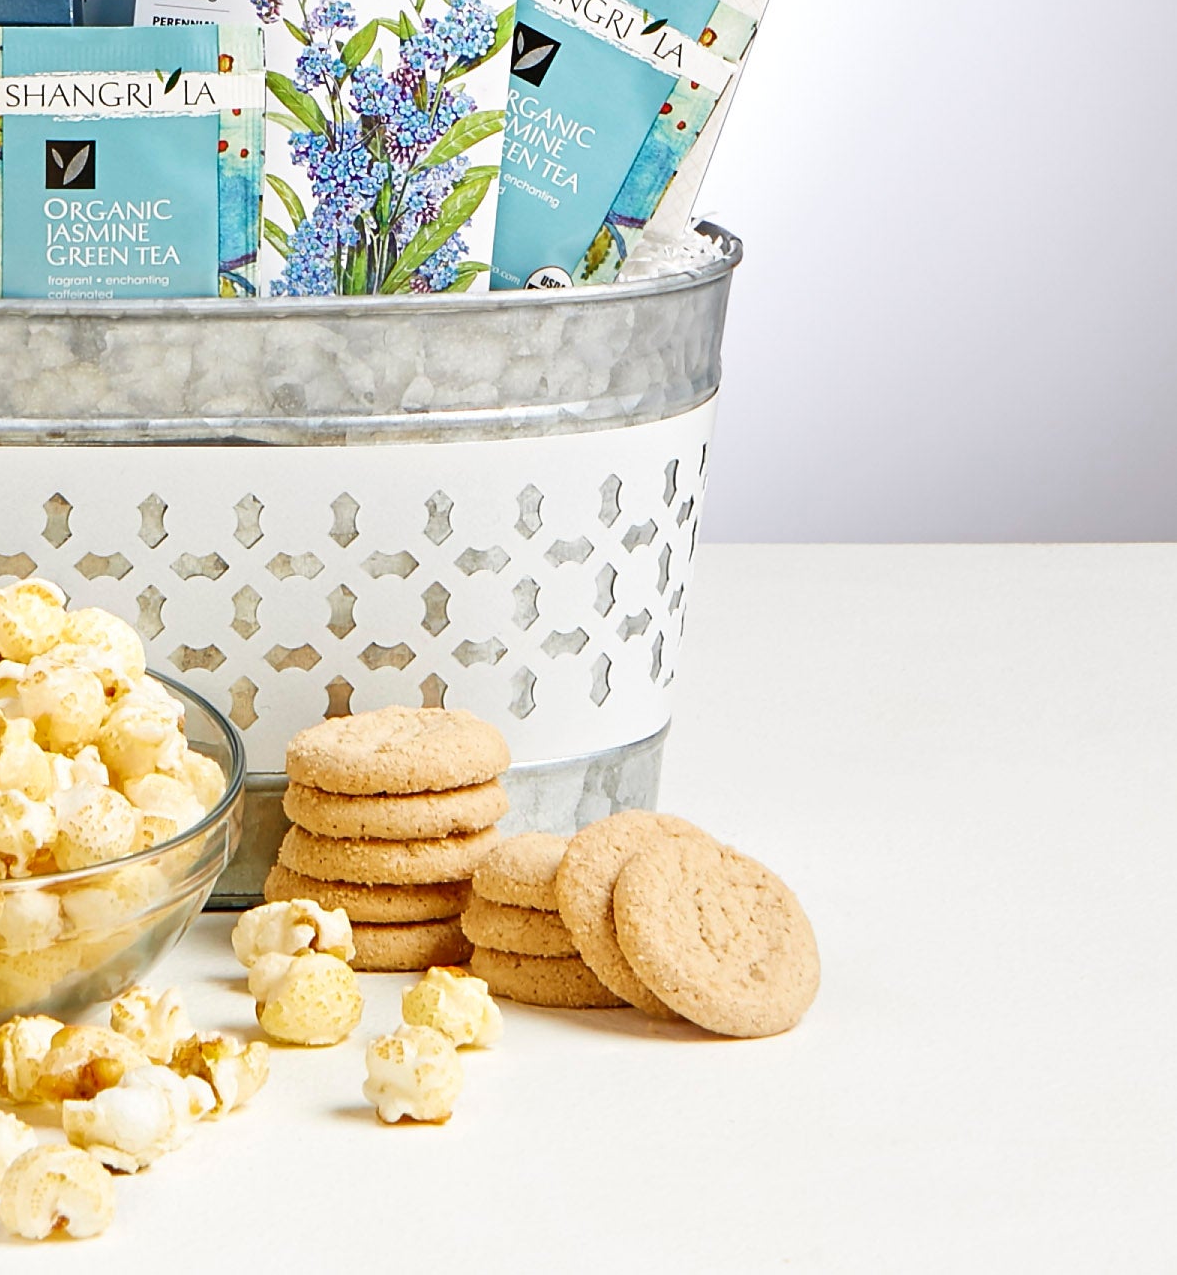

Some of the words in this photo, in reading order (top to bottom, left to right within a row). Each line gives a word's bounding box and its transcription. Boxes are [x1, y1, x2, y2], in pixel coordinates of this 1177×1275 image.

[152, 15, 215, 26] PERENN
[653, 32, 683, 68] LA
[5, 81, 153, 109] SHANGRI
[183, 80, 216, 106] LA
[543, 157, 579, 195] TEA
[503, 173, 561, 210] enchanting
[44, 197, 173, 223] ORGANIC
[46, 222, 150, 246] JASMINE
[46, 245, 129, 267] GREEN
[135, 245, 180, 266] TEA
[48, 275, 93, 287] fragrant
[105, 274, 170, 286] enchanting
[47, 289, 113, 300] caffeinated
